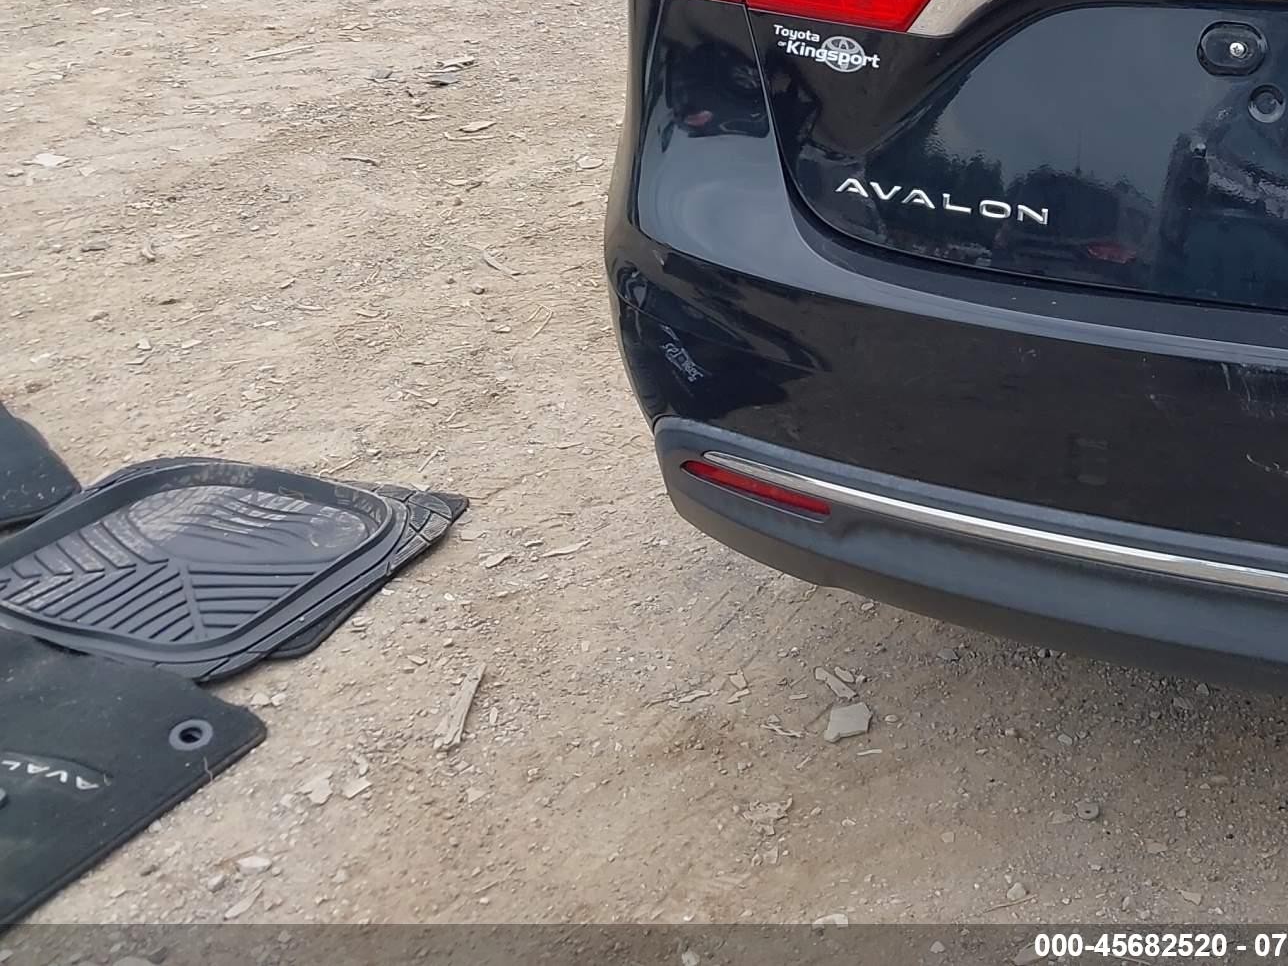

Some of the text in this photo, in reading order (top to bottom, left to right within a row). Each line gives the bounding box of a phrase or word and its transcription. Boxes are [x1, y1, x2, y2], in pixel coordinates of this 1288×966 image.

[773, 23, 820, 42] Toyota
[786, 39, 880, 69] Kingsport
[834, 177, 1050, 225] AVALON
